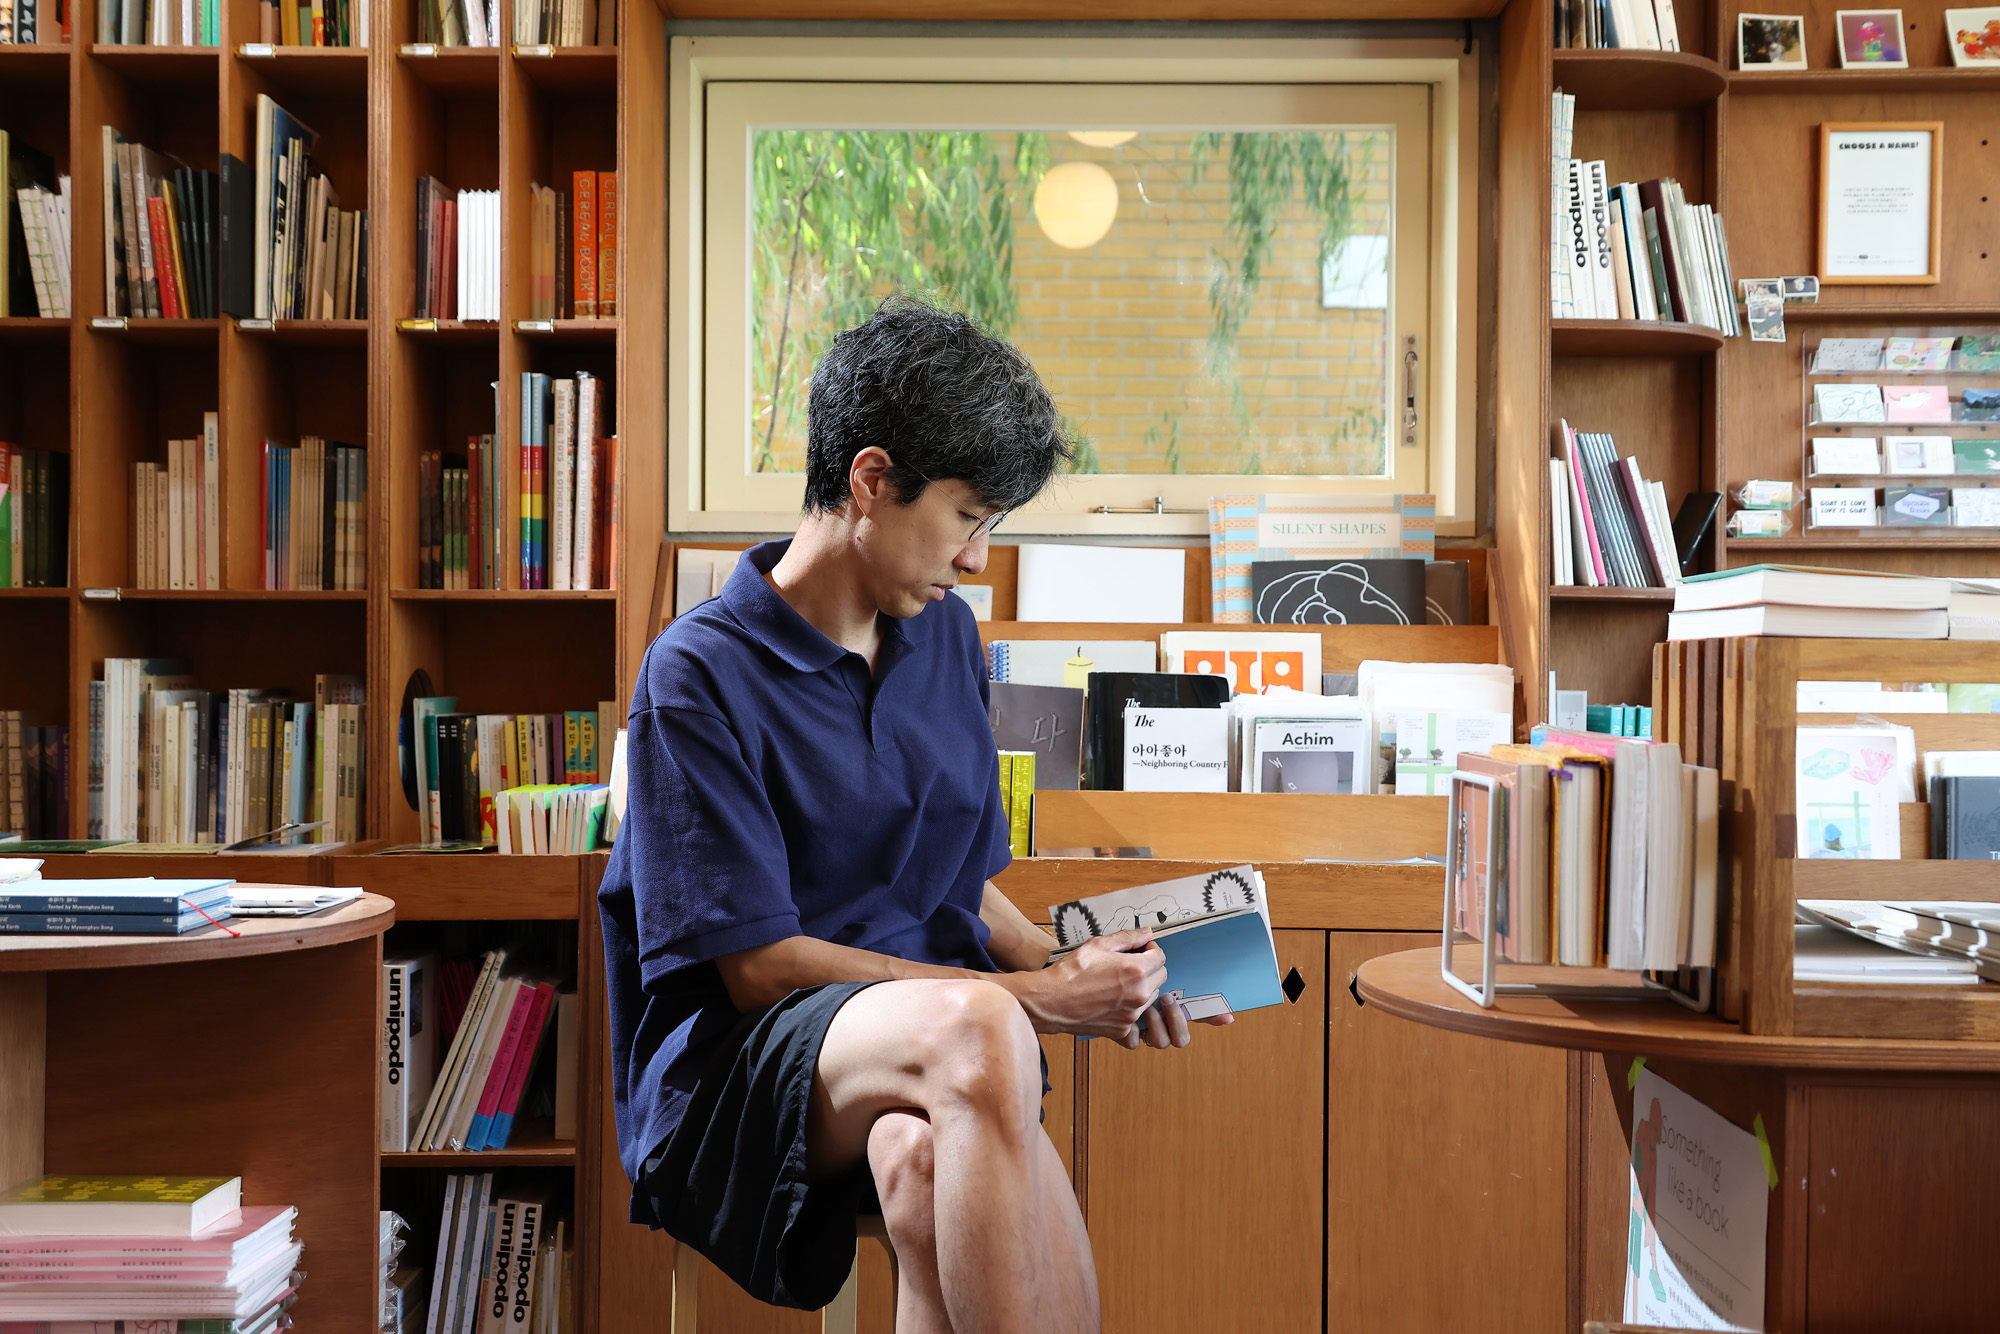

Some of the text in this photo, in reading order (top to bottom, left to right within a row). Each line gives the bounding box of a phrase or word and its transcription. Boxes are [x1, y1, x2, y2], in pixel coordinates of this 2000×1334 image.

[1838, 142, 1877, 150] CHOOSE
[1879, 142, 1886, 150] A
[139, 211, 149, 232] and
[1569, 162, 1589, 268] umipodo
[1591, 163, 1612, 269] umipodo
[578, 177, 592, 293] CEREAL BOOK
[603, 178, 616, 293] CEREAL BOOK
[140, 237, 150, 268] Dying
[556, 439, 565, 463] TOYS
[555, 478, 564, 508] OTHER
[579, 478, 587, 508] OTHER
[555, 509, 563, 562] MEMORIALS
[577, 509, 586, 562] MEMORIALS
[1272, 523, 1387, 534] SILENT SHAPES
[1125, 697, 1141, 708] The
[1134, 714, 1155, 728] The
[1132, 743, 1187, 758] 아아좋아
[1281, 732, 1334, 745] Achim
[1189, 760, 1221, 770] Country
[388, 968, 405, 1085] umipodo
[1661, 1115, 1722, 1192] Something
[1667, 1164, 1729, 1239] like a book
[493, 1203, 516, 1319] umipodo
[514, 1206, 537, 1324] umipodo
